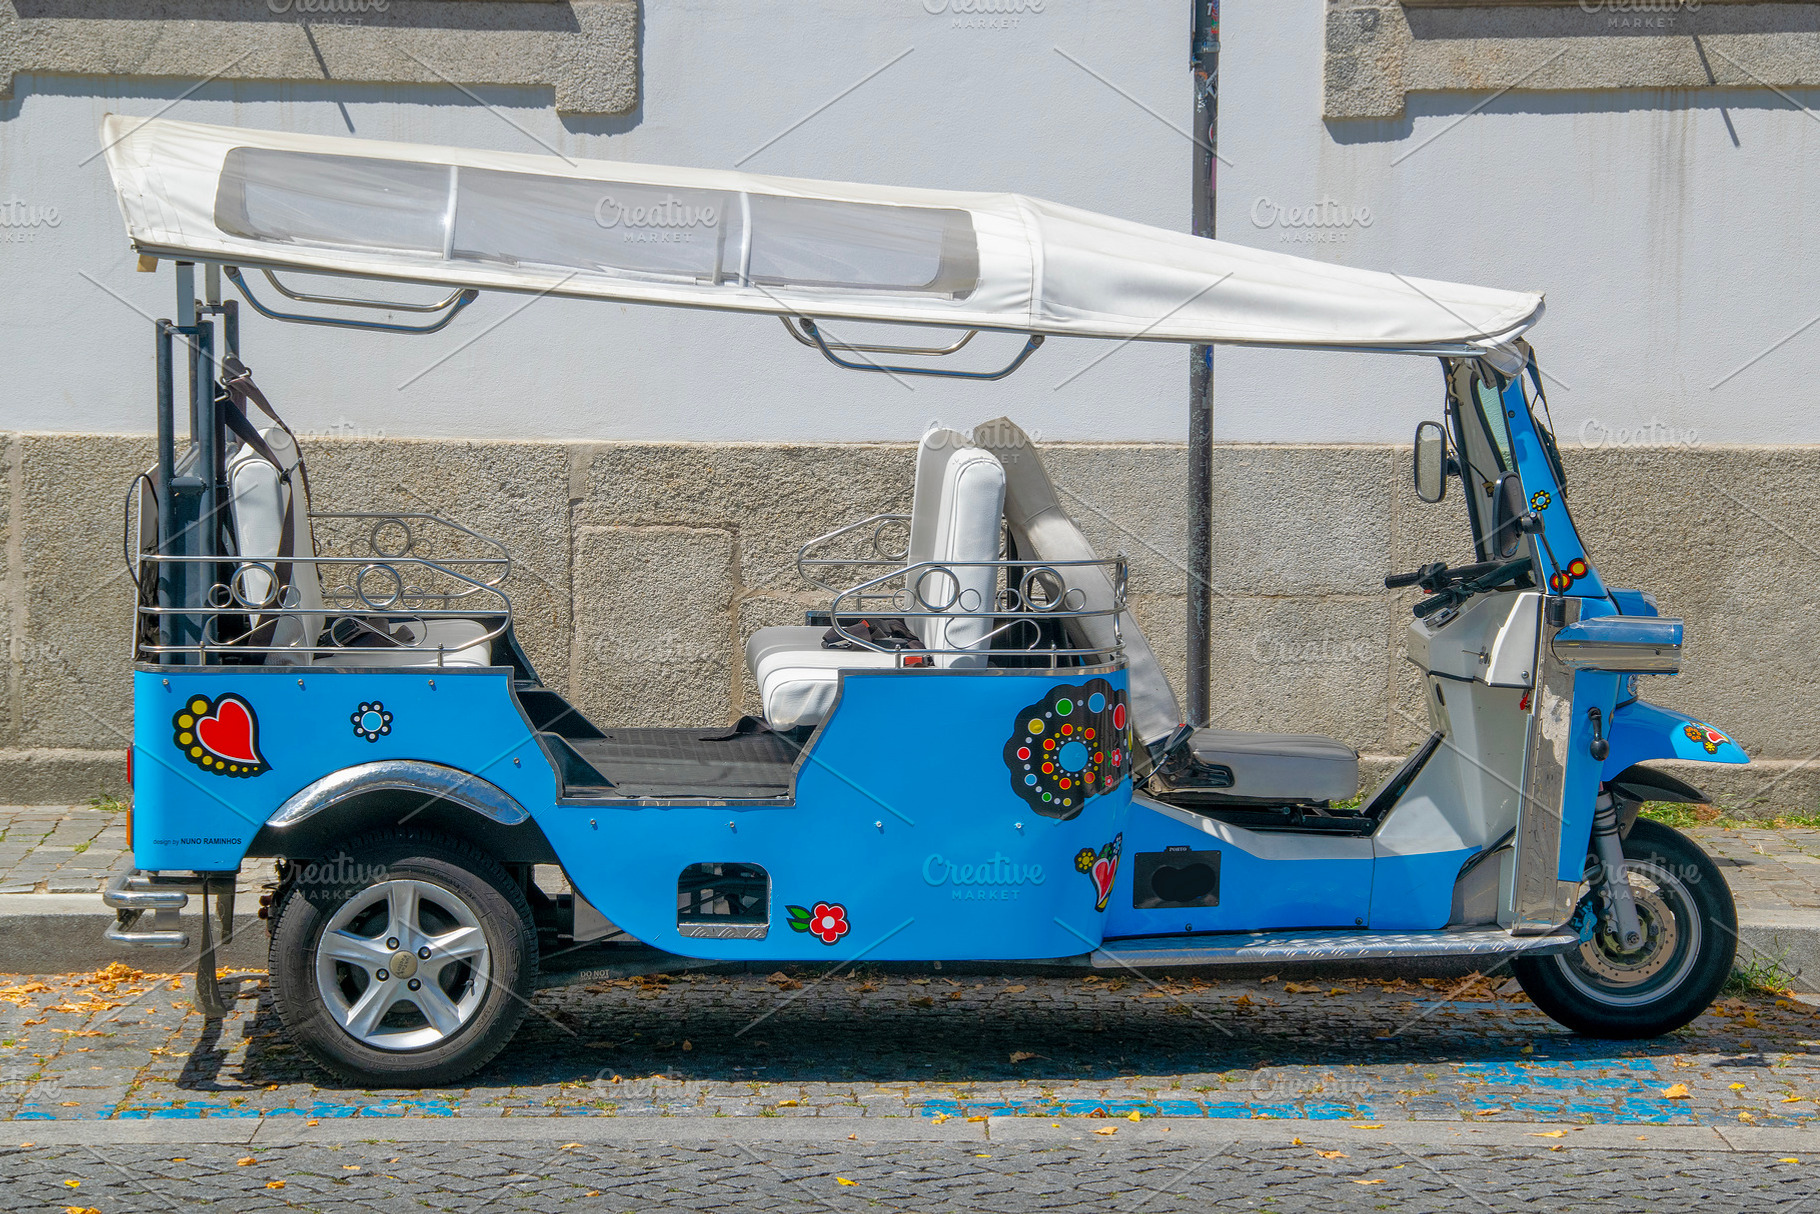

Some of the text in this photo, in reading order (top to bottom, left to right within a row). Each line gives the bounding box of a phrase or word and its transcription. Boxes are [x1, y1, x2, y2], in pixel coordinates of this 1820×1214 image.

[153, 838, 171, 846] design
[580, 969, 610, 978] DO NOT
